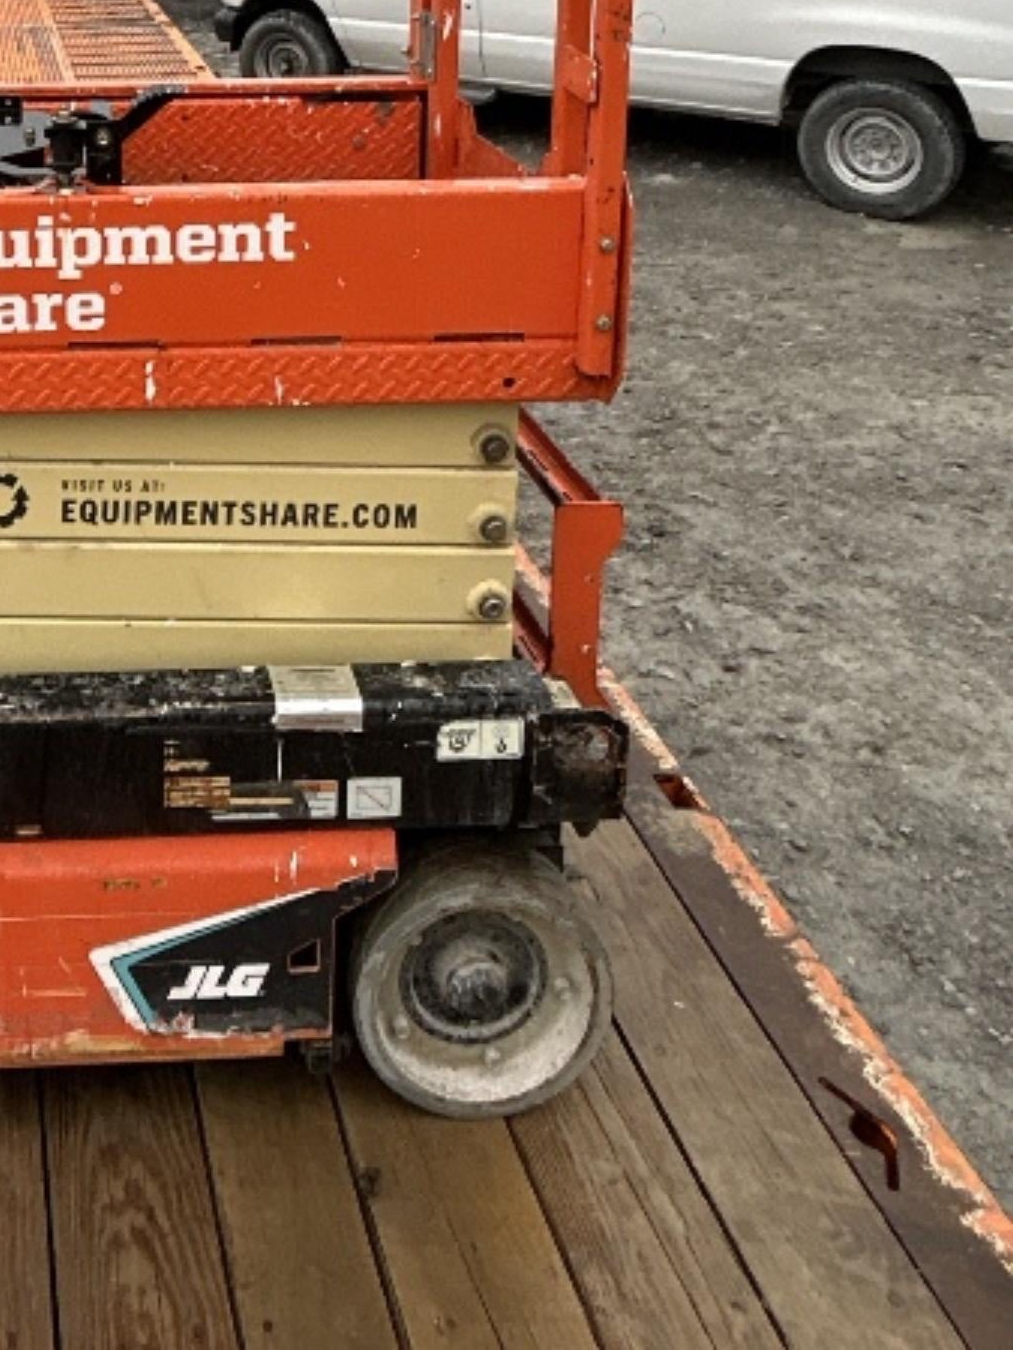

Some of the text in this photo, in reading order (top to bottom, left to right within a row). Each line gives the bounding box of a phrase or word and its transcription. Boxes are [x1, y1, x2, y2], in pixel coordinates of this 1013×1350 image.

[61, 479, 106, 493] VISIT
[112, 479, 133, 493] US
[60, 498, 419, 530] EQUIPMENTSHARE.COM
[166, 961, 271, 1001] JLG
